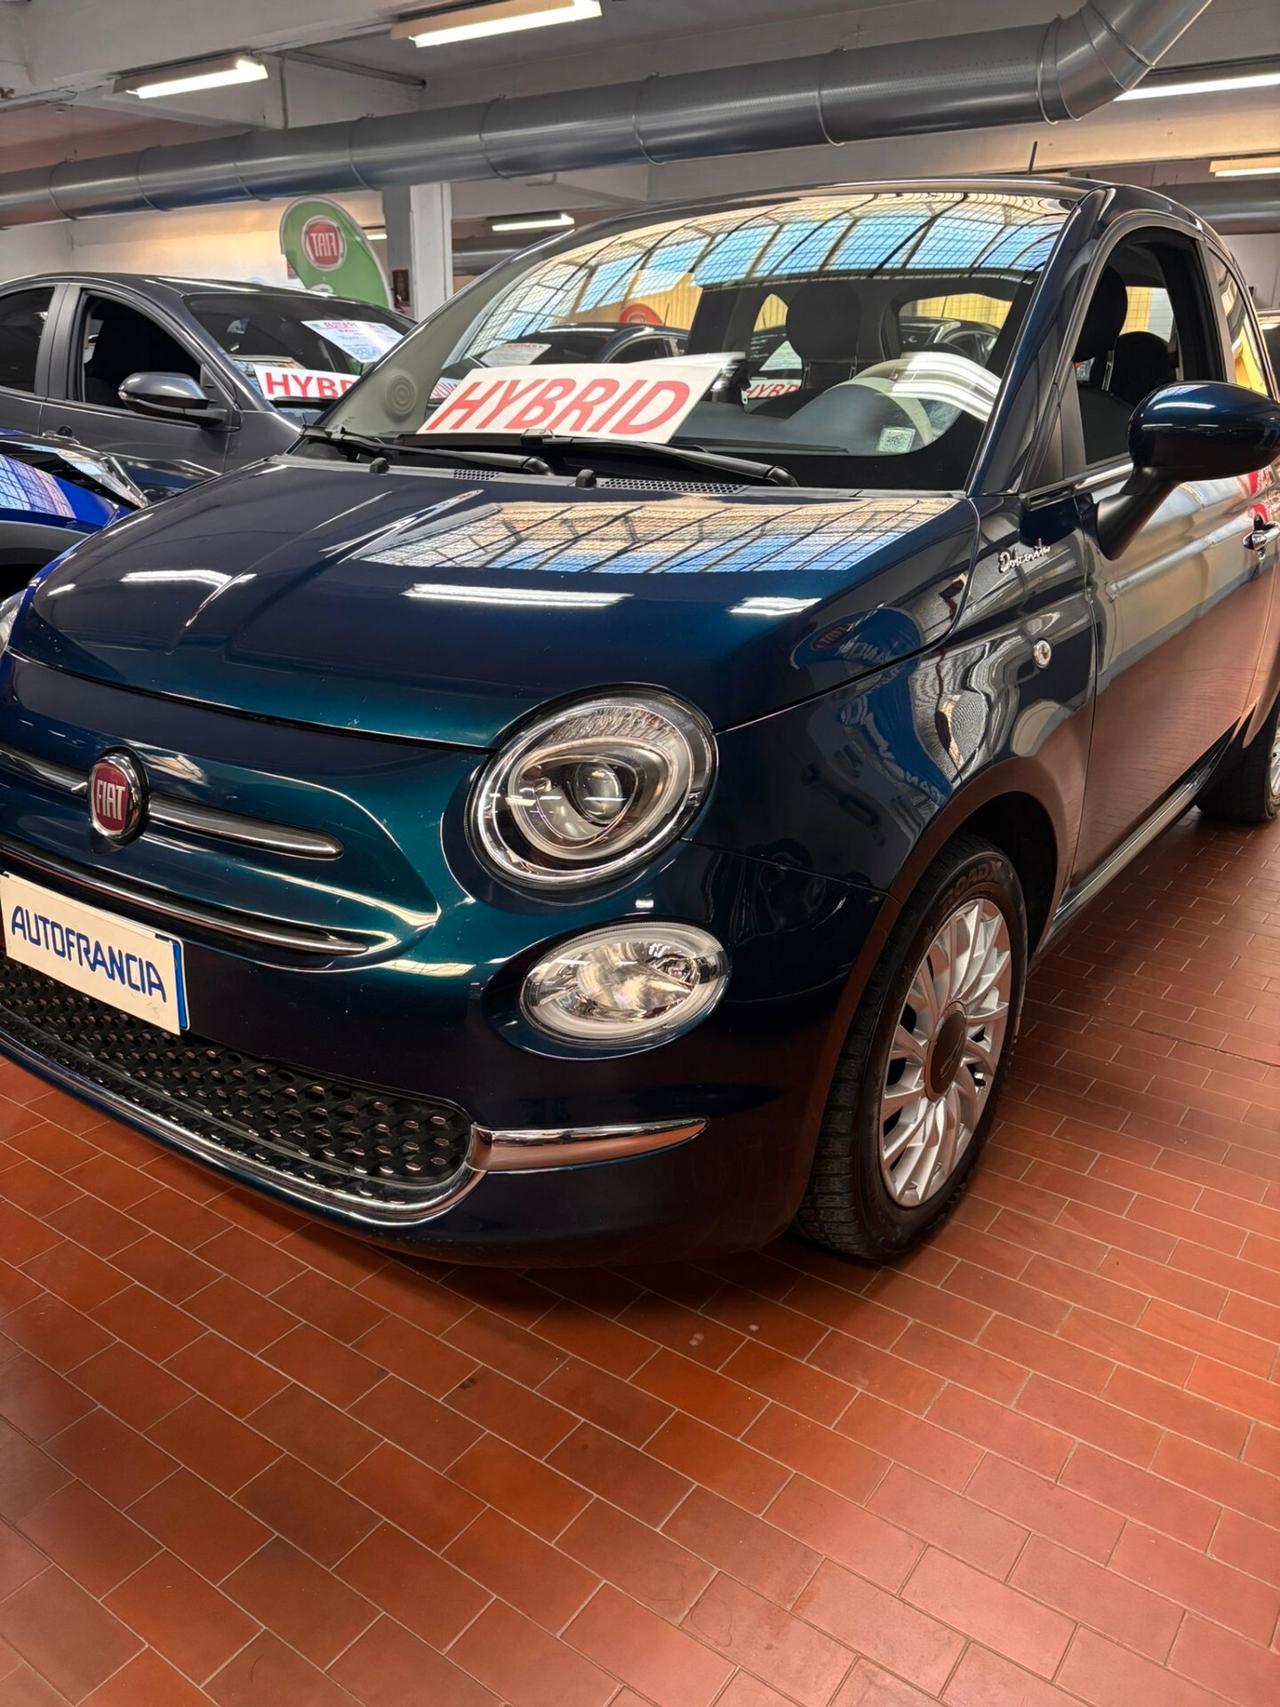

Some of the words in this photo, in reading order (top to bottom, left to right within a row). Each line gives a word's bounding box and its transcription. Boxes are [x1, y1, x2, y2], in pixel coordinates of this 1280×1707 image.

[426, 378, 690, 434] HYBRID
[96, 779, 126, 820] FIAT
[11, 905, 167, 1004] AUTOFRANCIA
